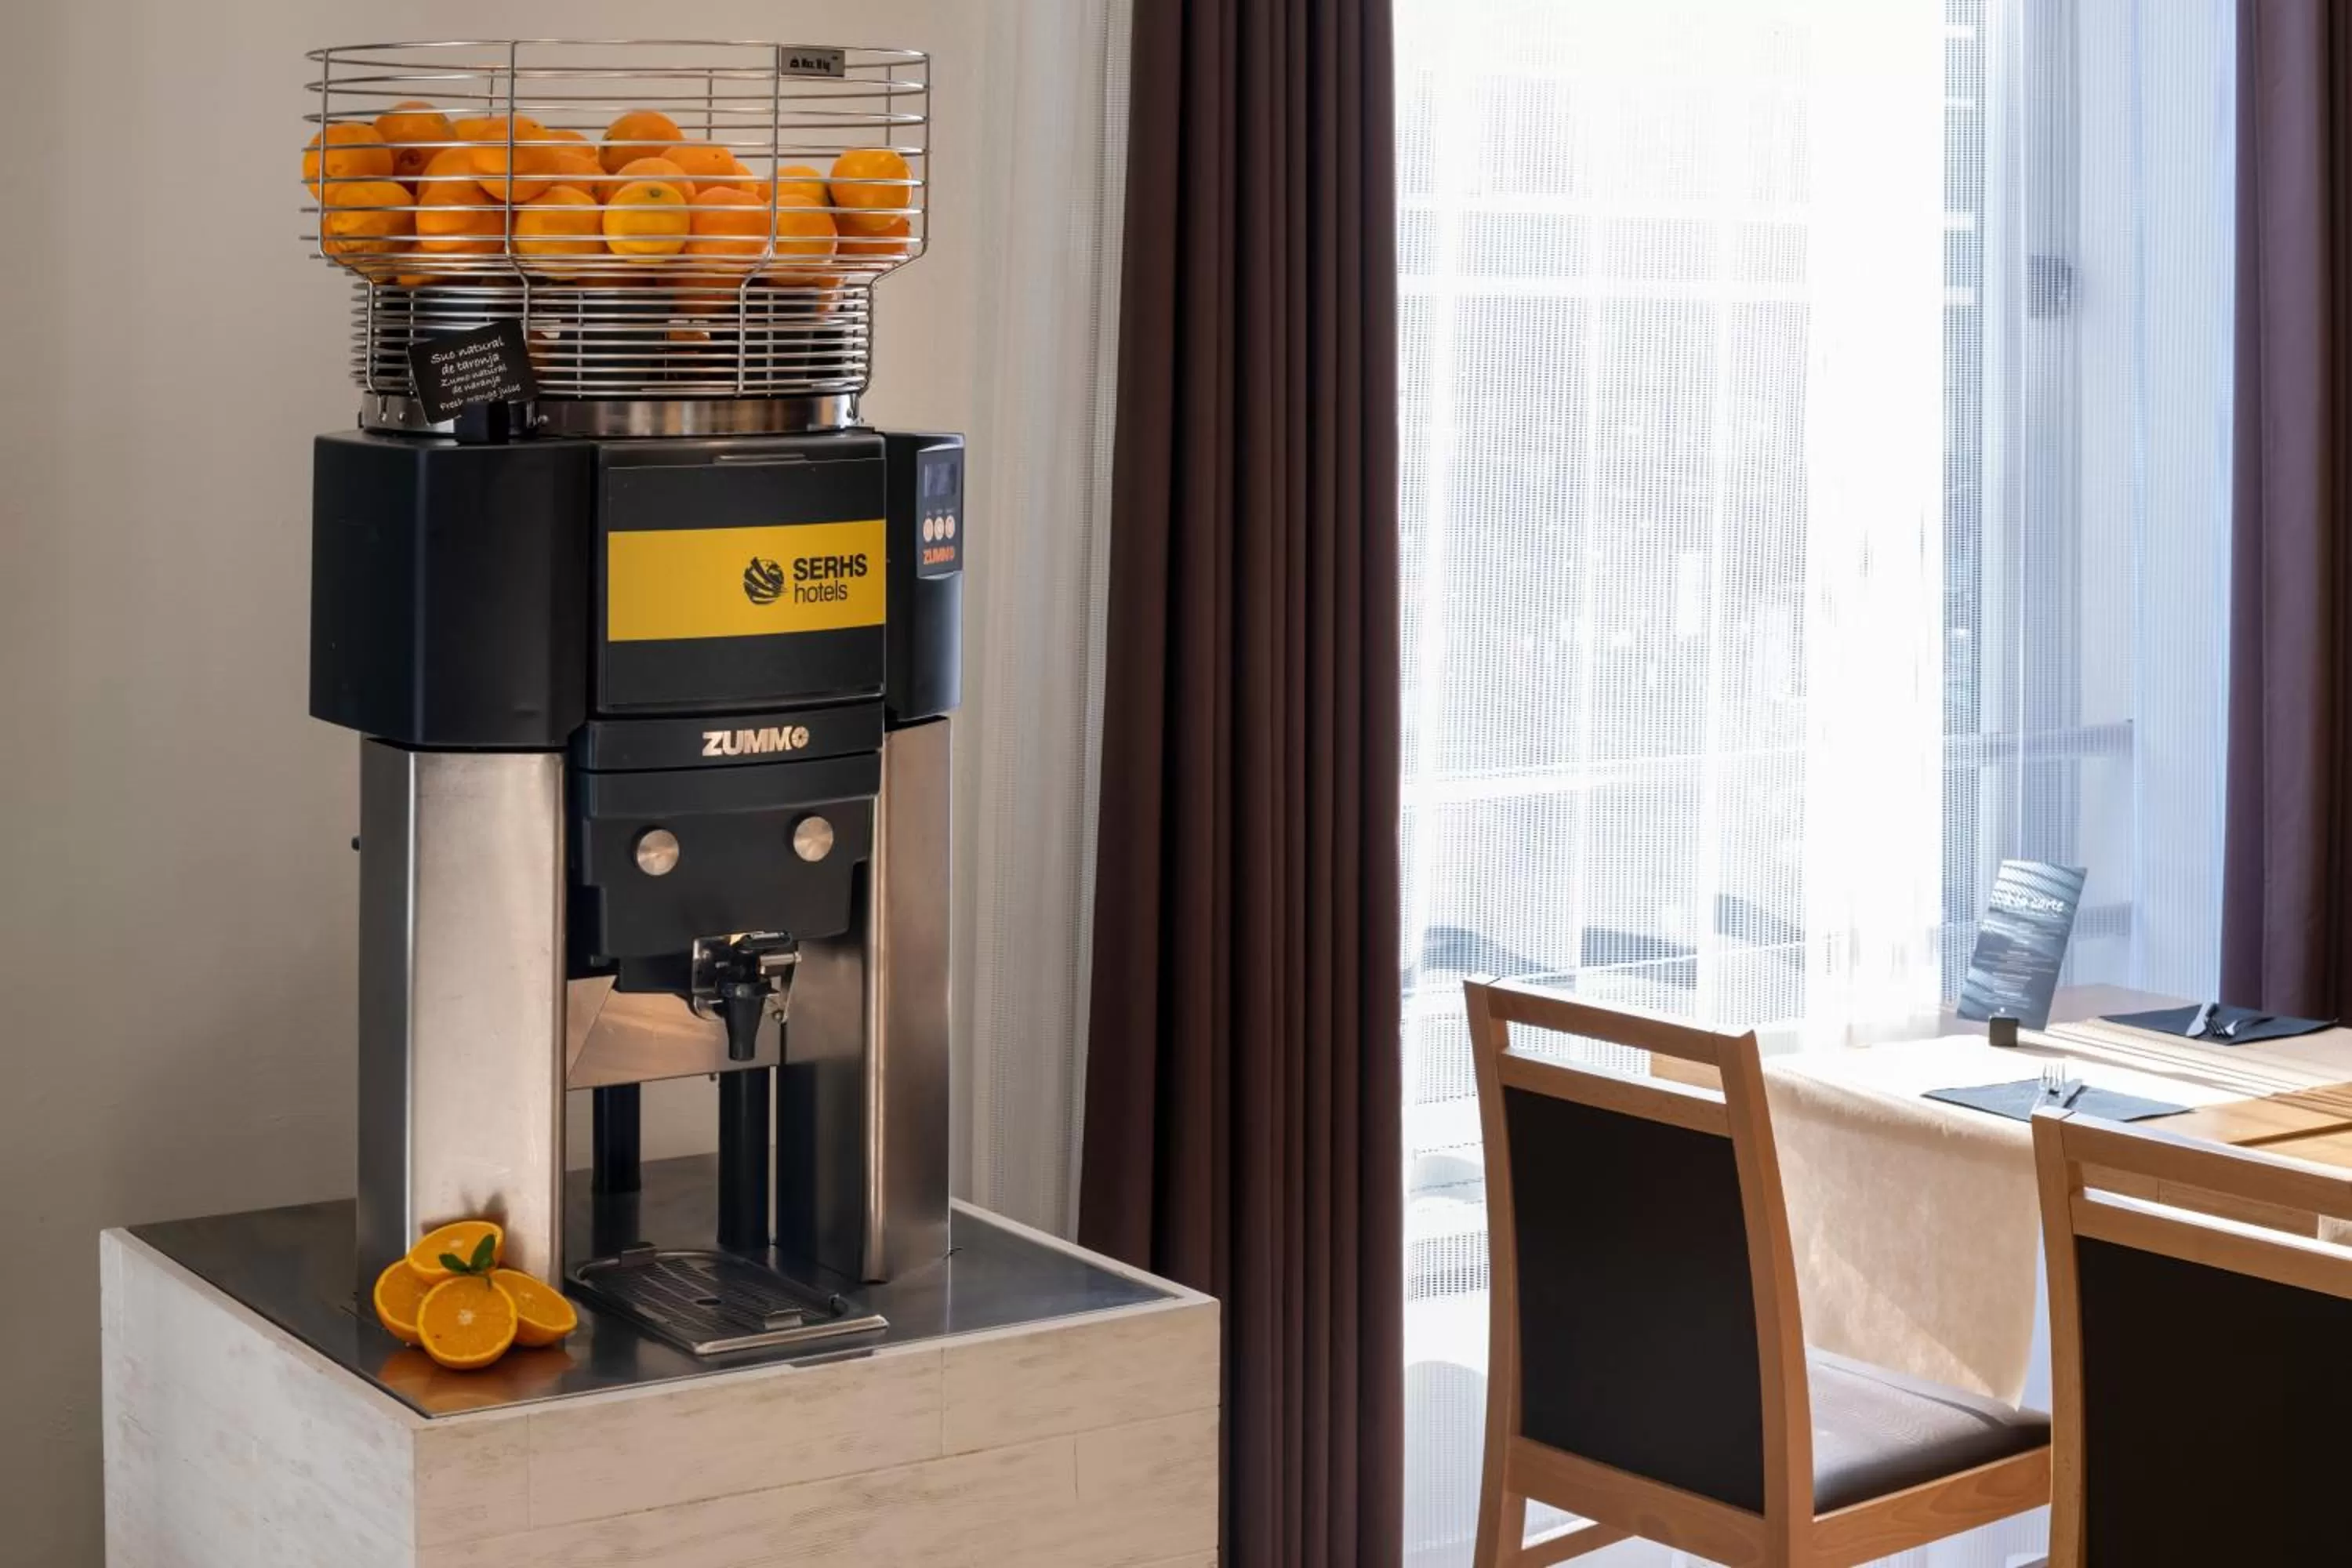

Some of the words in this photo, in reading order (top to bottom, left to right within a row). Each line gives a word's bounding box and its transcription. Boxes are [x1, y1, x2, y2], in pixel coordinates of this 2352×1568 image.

[459, 336, 505, 356] natural
[441, 364, 456, 375] de
[457, 353, 500, 371] taronja
[441, 375, 470, 387] Zumo
[473, 364, 507, 379] natural
[452, 384, 463, 394] de
[464, 376, 501, 390] naranja
[924, 546, 955, 565] ZUMMO
[793, 553, 868, 581] SERHS
[794, 580, 848, 604] hotels
[702, 725, 809, 757] ZUMMO
